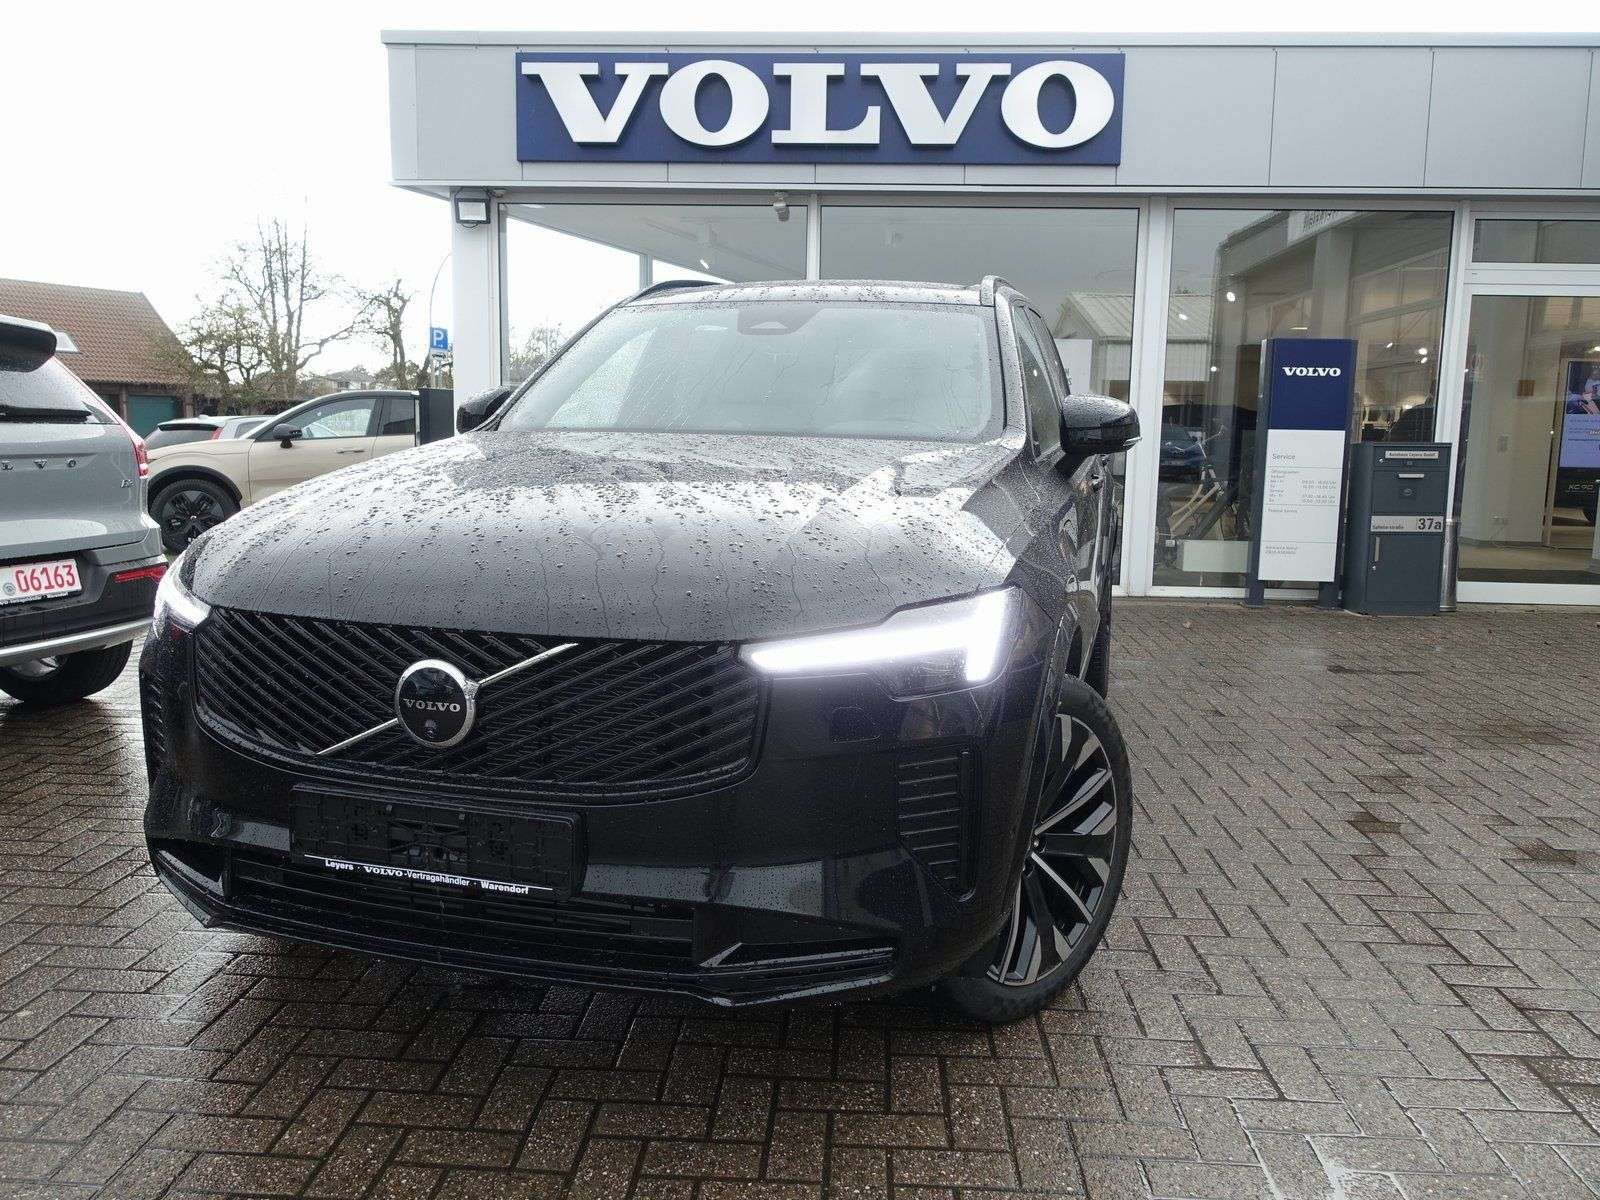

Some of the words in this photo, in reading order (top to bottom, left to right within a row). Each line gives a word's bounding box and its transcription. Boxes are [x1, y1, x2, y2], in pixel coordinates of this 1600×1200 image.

[521, 59, 1115, 149] VOLVO
[433, 329, 444, 346] P
[1281, 366, 1342, 377] VOLVO
[1272, 453, 1296, 461] Service
[1418, 517, 1442, 530] 37a
[15, 564, 76, 592] 06163
[403, 698, 461, 713] VOLVO
[325, 859, 354, 870] Leyers
[480, 880, 529, 894] Warendorf
